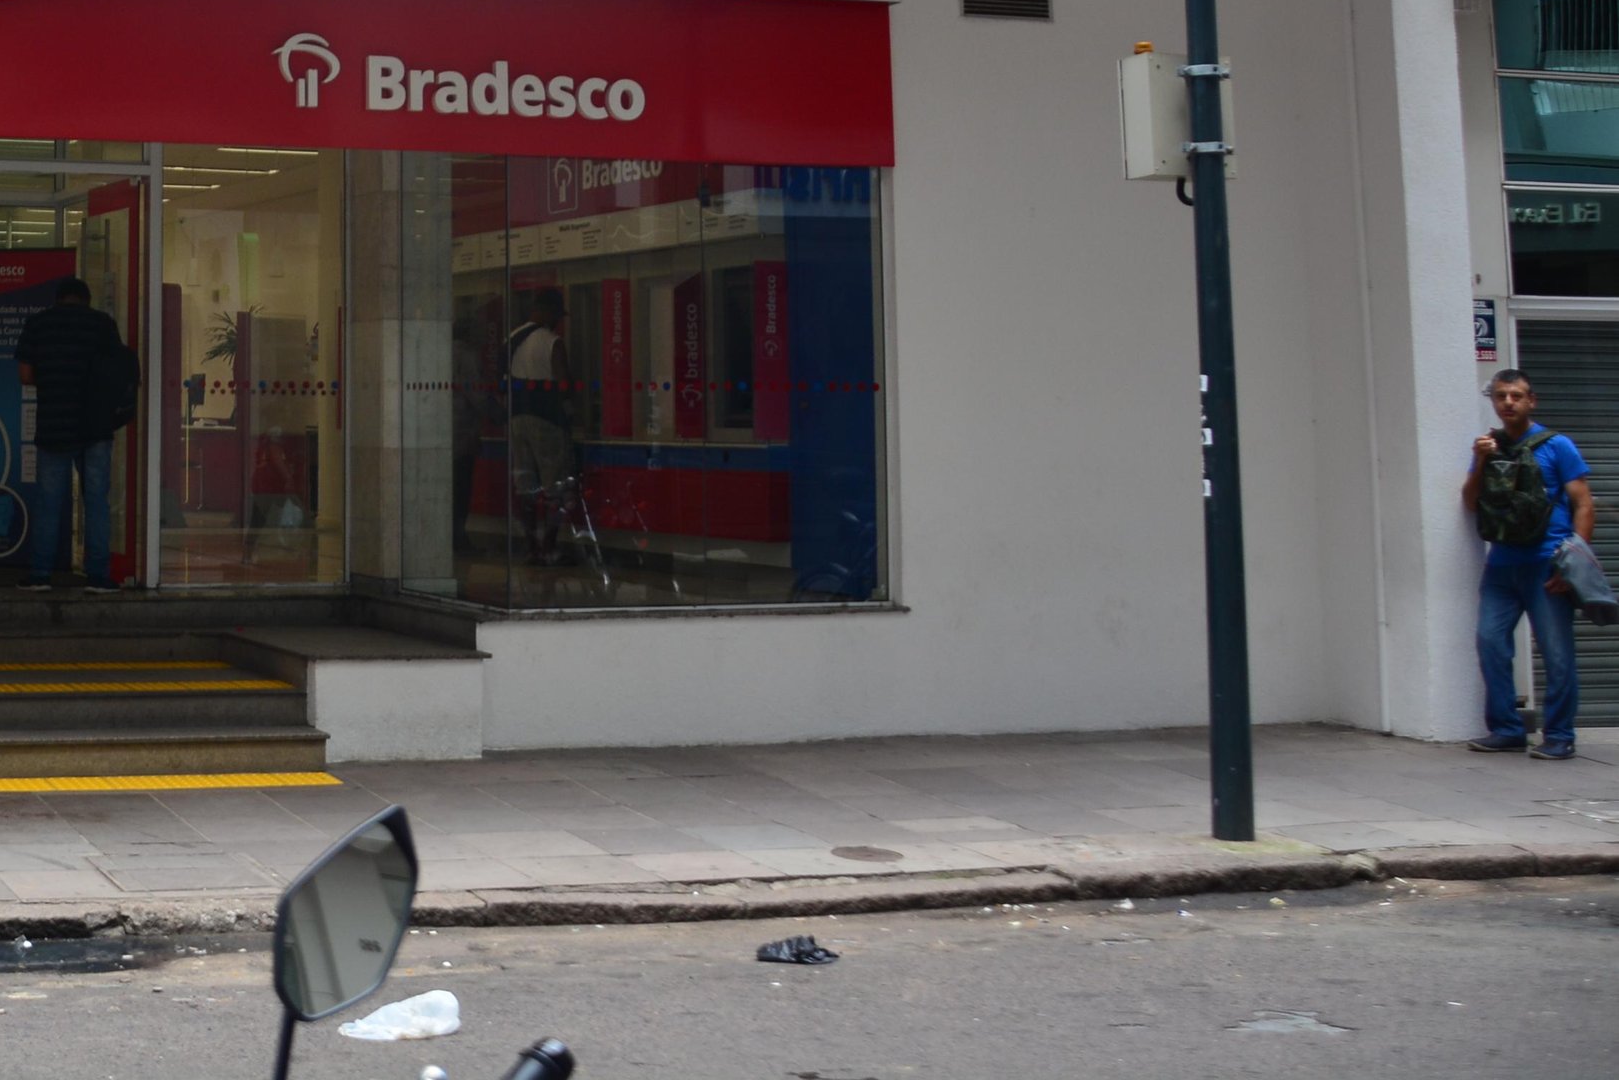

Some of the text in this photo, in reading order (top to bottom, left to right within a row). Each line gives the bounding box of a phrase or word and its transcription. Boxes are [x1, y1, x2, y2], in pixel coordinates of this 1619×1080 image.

[366, 55, 646, 121] Bradesco
[582, 159, 663, 190] Bradesco
[613, 290, 622, 343] Bradesco
[765, 274, 777, 334] Bradesco
[684, 303, 698, 379] bradesco
